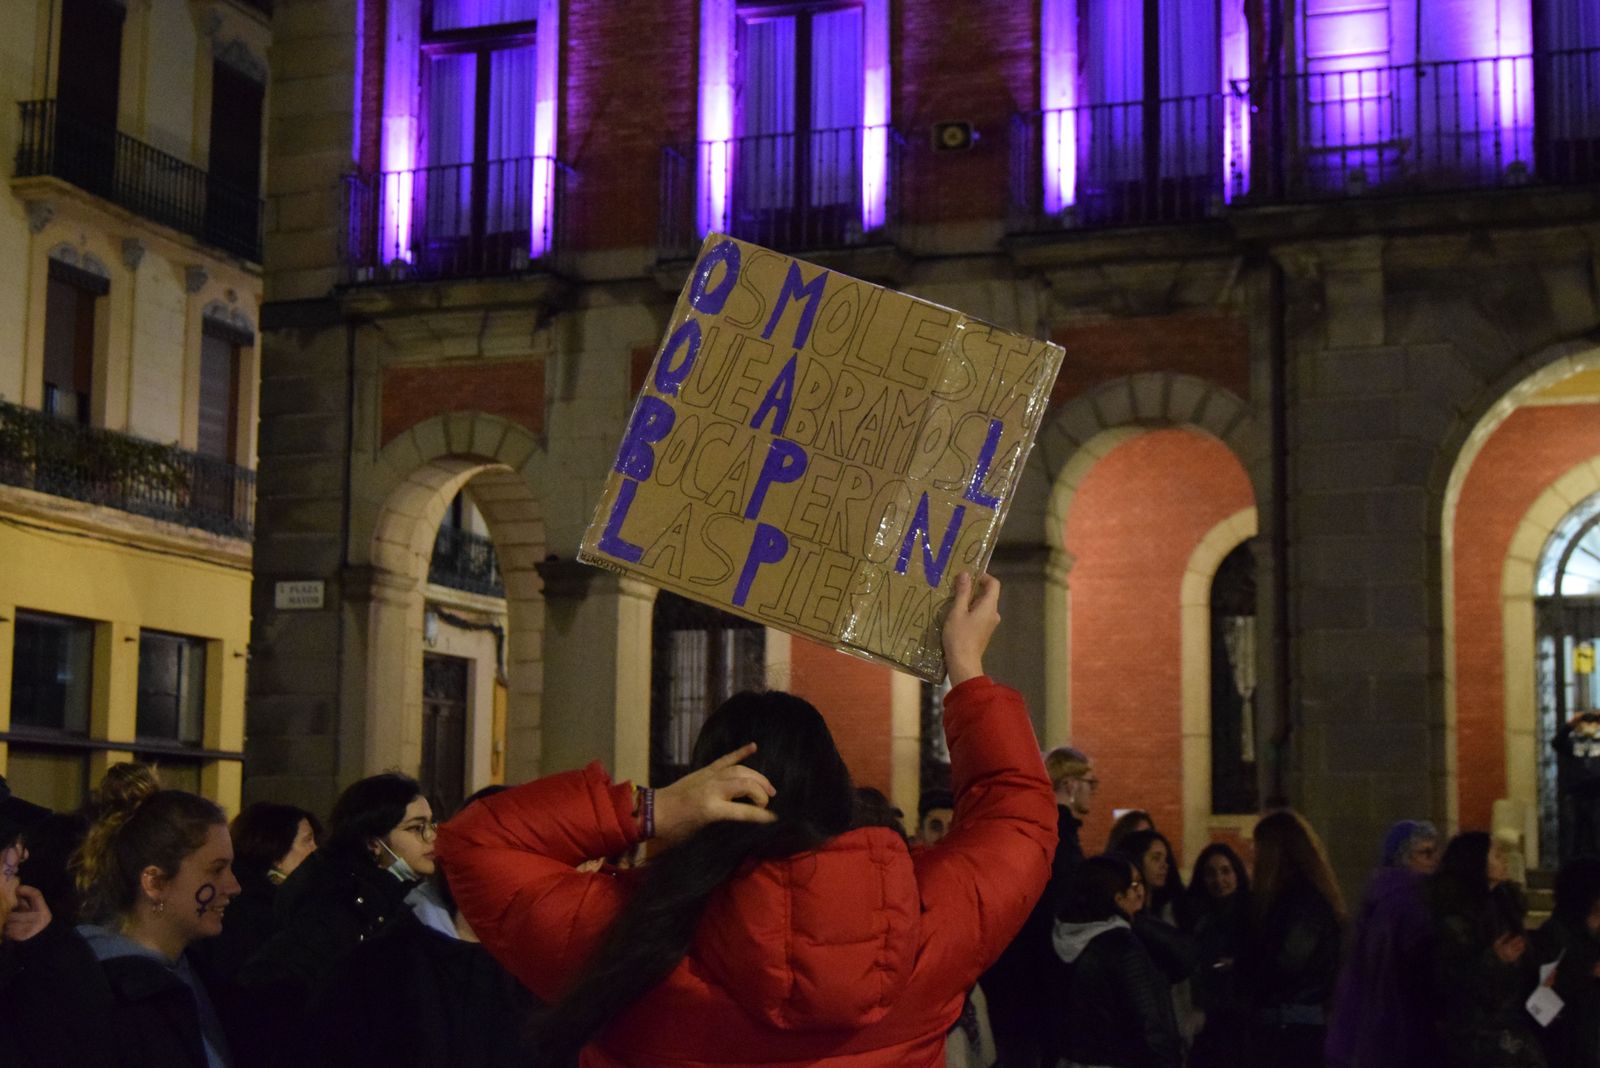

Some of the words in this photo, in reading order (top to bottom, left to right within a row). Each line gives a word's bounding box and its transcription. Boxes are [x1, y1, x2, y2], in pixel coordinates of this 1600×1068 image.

[655, 323, 776, 425] QUE
[750, 350, 991, 491] ABRAMOS
[962, 419, 1022, 510] LA
[689, 239, 788, 329] OS
[760, 259, 1049, 429] MOLESTA
[598, 478, 746, 587] LAS
[614, 395, 756, 516] BOCA
[744, 439, 912, 565] PERO
[894, 490, 998, 589] NO
